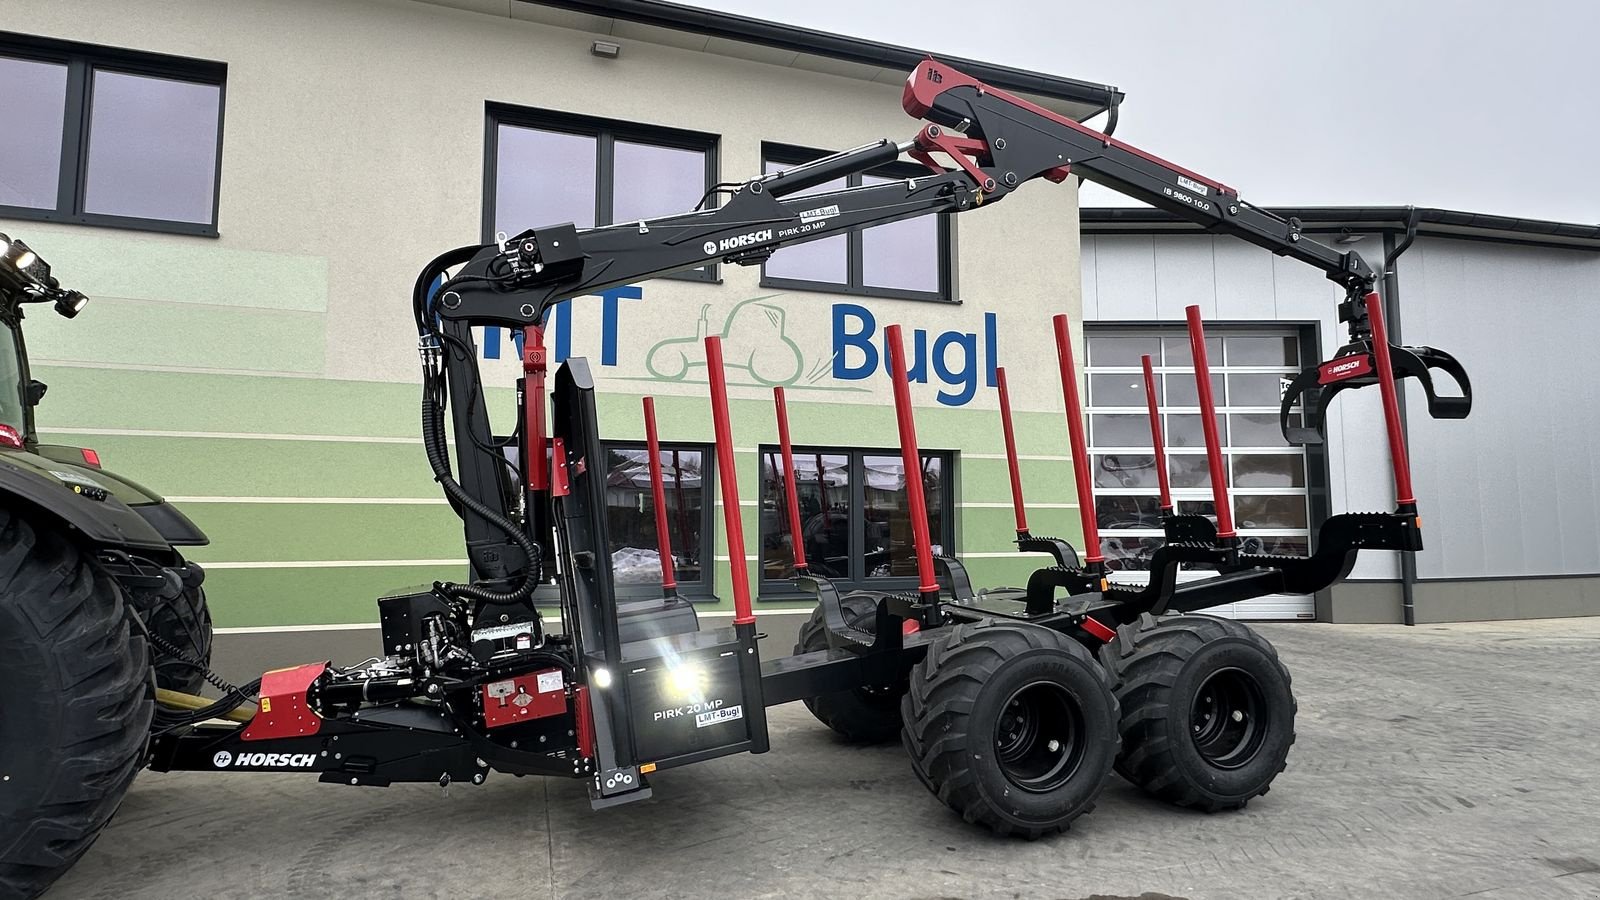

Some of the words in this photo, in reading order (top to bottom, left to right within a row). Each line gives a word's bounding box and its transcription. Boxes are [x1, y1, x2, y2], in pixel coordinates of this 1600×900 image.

[1163, 187, 1172, 196] IB
[1173, 191, 1192, 204] 9800
[1194, 199, 1210, 211] 10.0
[719, 229, 772, 251] HORSCH
[778, 226, 800, 238] PIRK
[801, 224, 811, 233] 20
[812, 221, 826, 231] MP
[832, 303, 998, 406] Bugl
[1333, 360, 1360, 373] HORSCH
[653, 707, 684, 721] PIRK
[686, 703, 701, 715] 20
[704, 699, 723, 711] MP
[698, 707, 740, 723] LMT-Bugl
[234, 752, 317, 767] HORSCH
